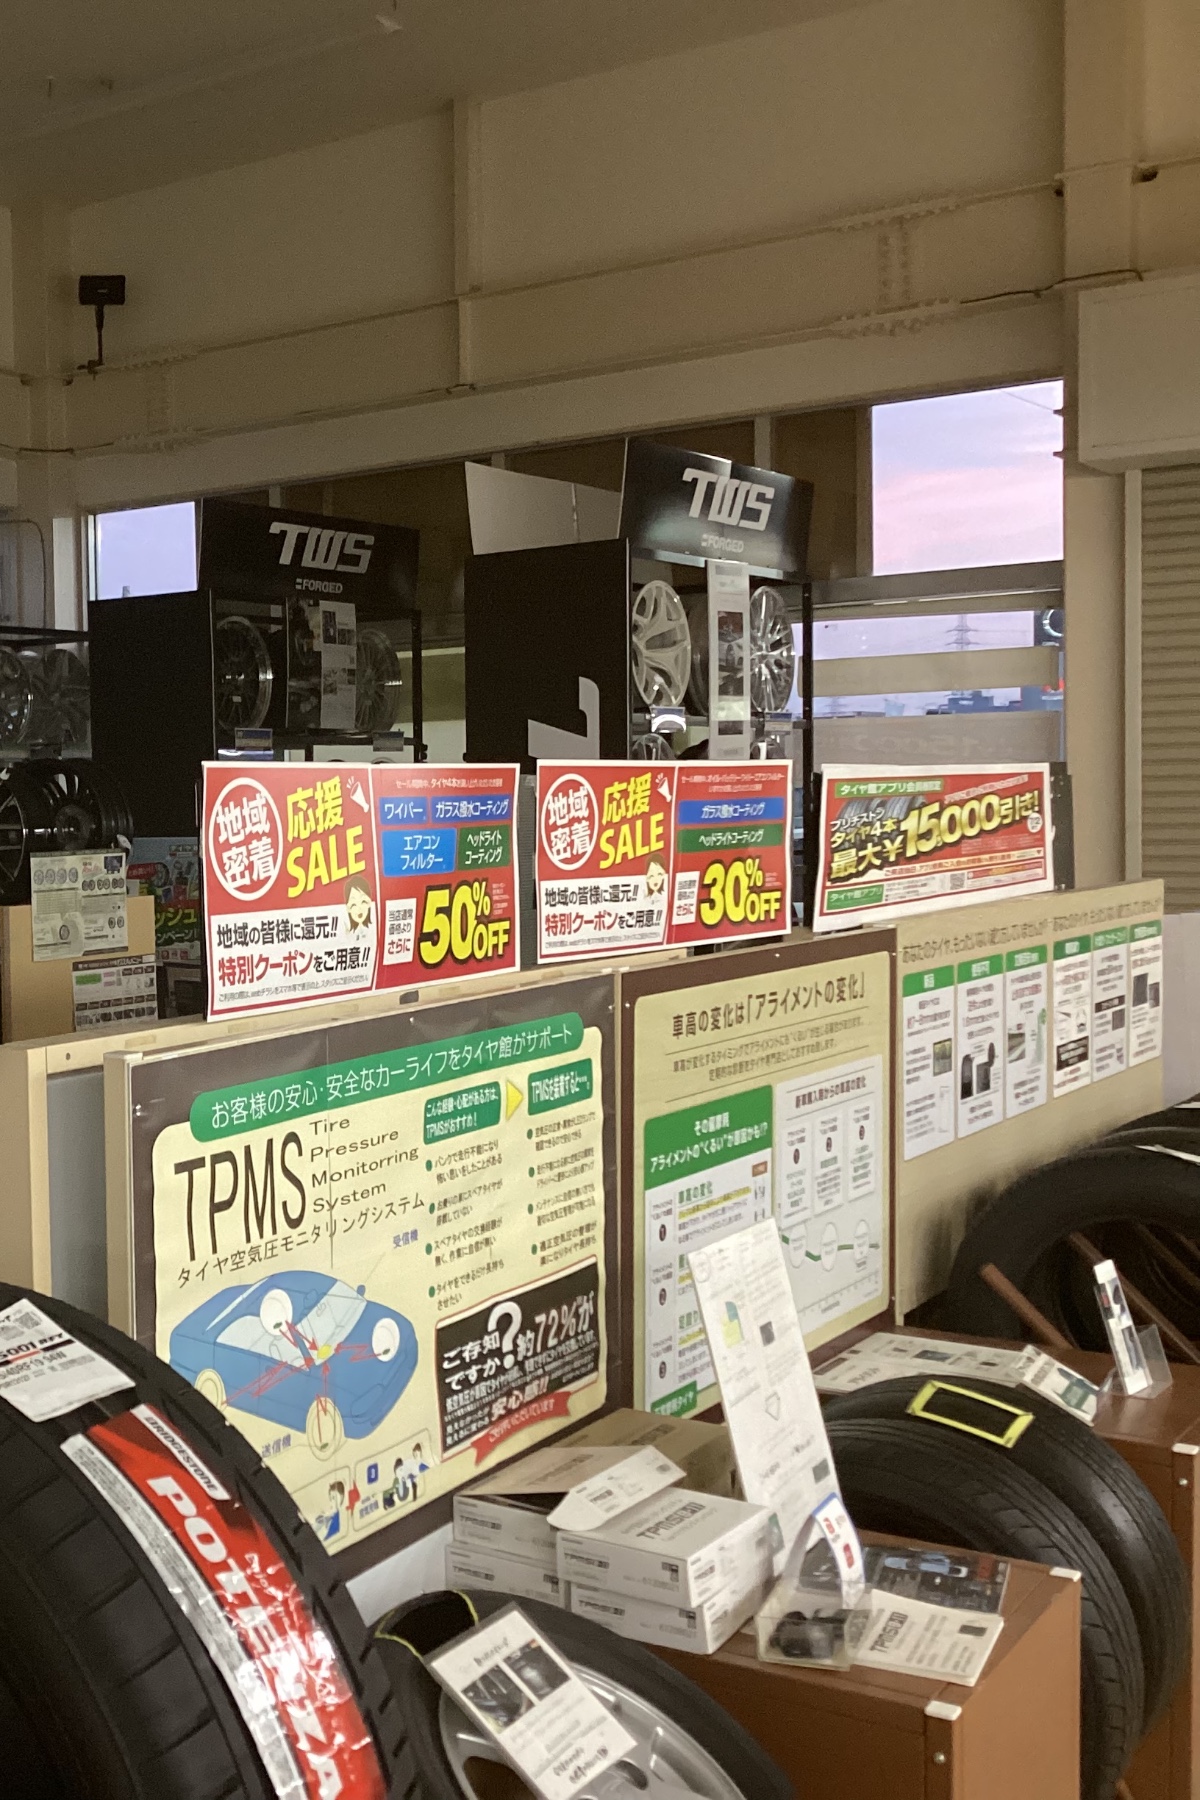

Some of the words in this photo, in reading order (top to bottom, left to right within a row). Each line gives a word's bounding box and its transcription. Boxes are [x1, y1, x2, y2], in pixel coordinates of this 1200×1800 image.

[682, 467, 775, 531] TWS
[269, 522, 375, 574] TWS
[707, 534, 745, 553] FORGED
[302, 579, 343, 594] FORGED
[216, 793, 271, 843] 地域
[286, 775, 344, 843] 応援
[384, 802, 423, 819] ワイパー
[435, 799, 509, 818] ガラス撥水コーティング
[548, 786, 589, 826] 地域
[602, 772, 652, 826] 応援
[403, 835, 440, 851] エアコン
[467, 829, 502, 847] ヘッドライト
[550, 822, 592, 860] 密着
[599, 812, 664, 870] SALE
[830, 819, 898, 848] タイヤ4本
[222, 838, 275, 887] 密着
[286, 825, 366, 899] SALE
[400, 852, 443, 870] フィルター
[465, 846, 503, 865] コーティング
[387, 937, 411, 955] さらに
[672, 972, 865, 1040] 車高の変化は「アライメントの変化」
[211, 1023, 573, 1129] お客様の安心・安全なカーライフをタイヤ館がサポート
[310, 1118, 350, 1136] Tire
[311, 1130, 399, 1162] Pressure
[312, 1147, 419, 1187] Monitorring
[174, 1131, 306, 1262] TPMS
[313, 1183, 387, 1213] System
[178, 1192, 425, 1289] タイヤ空気圧モニタリングシステム
[393, 1229, 419, 1249] 受信機
[443, 1331, 500, 1369] ご存知
[445, 1357, 500, 1391] ですか
[145, 1416, 218, 1493] BRIDGESTONE
[261, 1434, 292, 1458] 送信機
